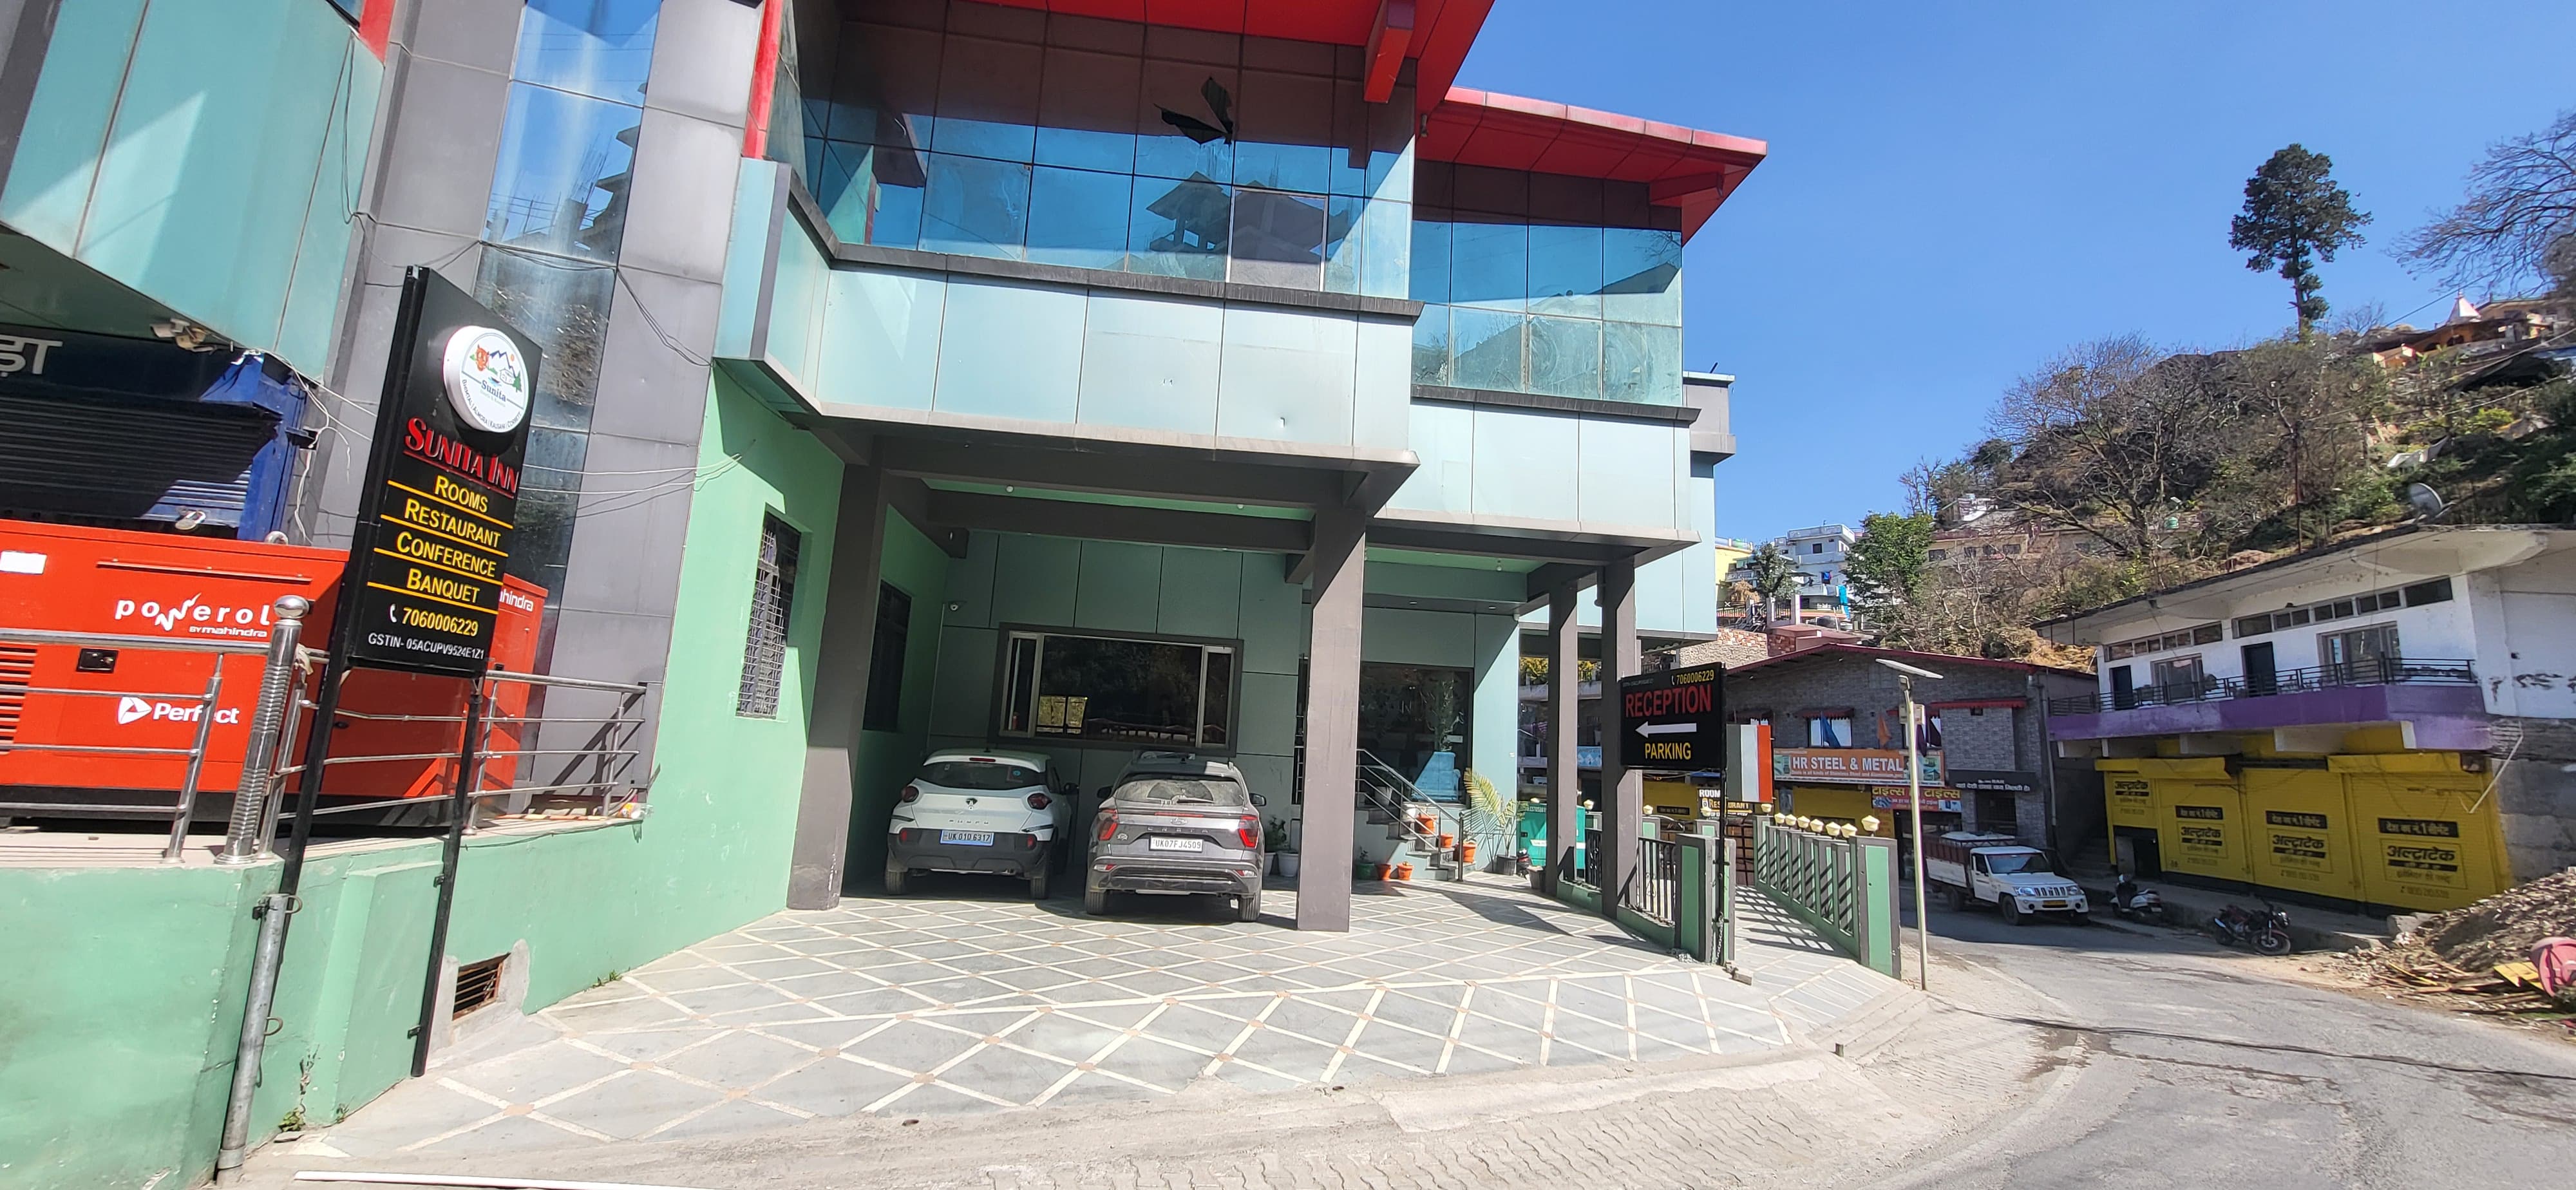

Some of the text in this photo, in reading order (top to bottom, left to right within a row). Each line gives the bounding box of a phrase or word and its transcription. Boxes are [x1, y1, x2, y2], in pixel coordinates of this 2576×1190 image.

[481, 380, 506, 402] Sunita
[404, 417, 519, 493] SUNITA INN
[435, 475, 488, 513] ROOMS
[404, 498, 501, 547] RESTAURANT
[397, 531, 497, 577] CONFERENCE
[407, 568, 480, 603] BANQUET
[202, 627, 267, 638] mahindra
[402, 607, 478, 637] 7060006229
[368, 632, 404, 648] GSTIN-
[1676, 670, 1714, 685] 7060006229
[1625, 685, 1712, 717] RECEPTION
[153, 703, 240, 724] Perfct
[1645, 742, 1691, 760] PARKING
[1793, 757, 1904, 771] HR STEEL & METAL
[1698, 789, 1721, 798] ROOM
[1709, 799, 1749, 809] RESURANT
[2387, 845, 2456, 862] अल्ट्राटेक
